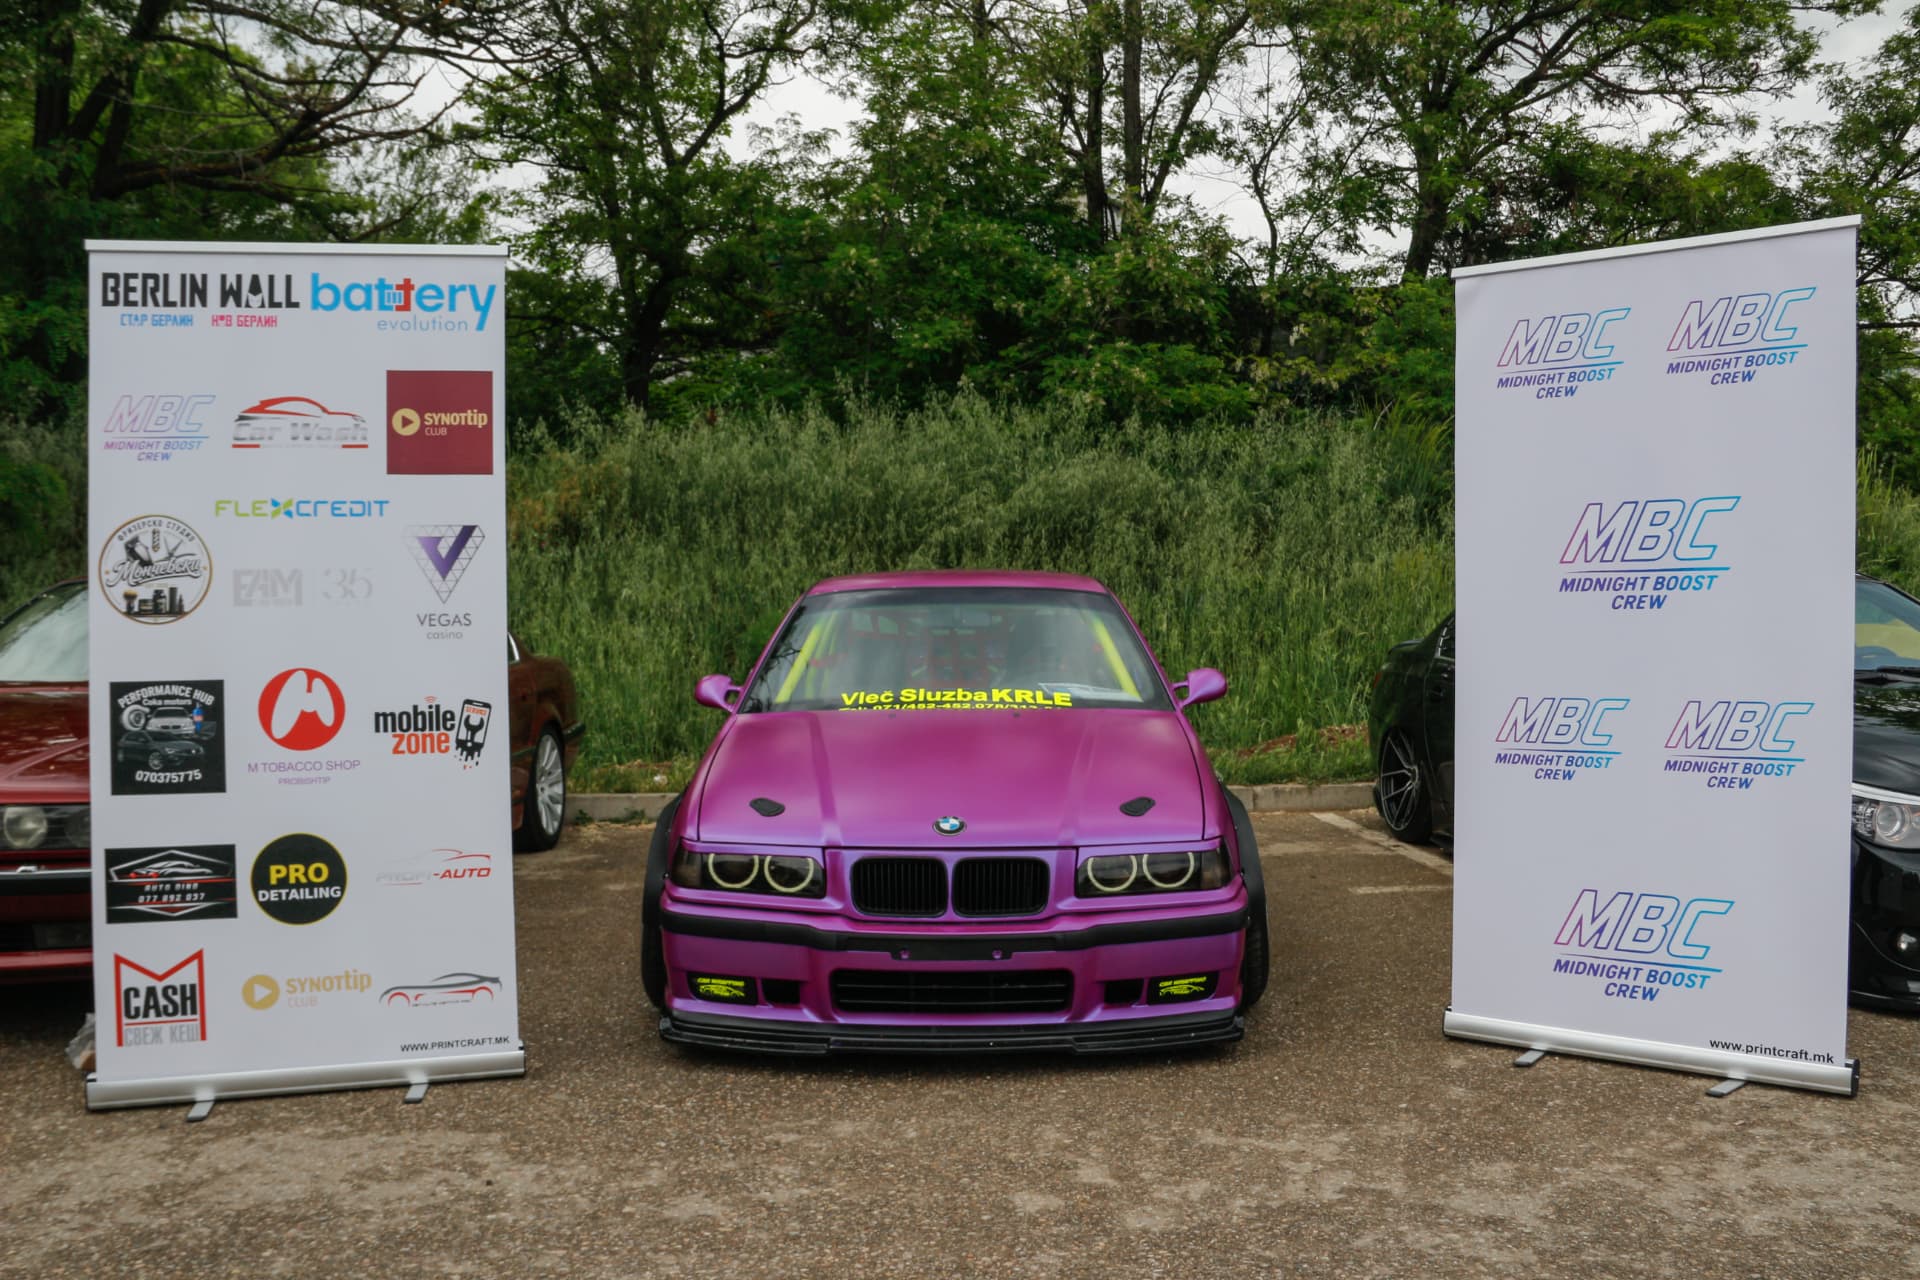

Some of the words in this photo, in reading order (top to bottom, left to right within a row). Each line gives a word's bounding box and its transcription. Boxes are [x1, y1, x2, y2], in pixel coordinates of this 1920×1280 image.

[102, 272, 208, 308] BERLIN
[220, 273, 300, 308] WALL
[310, 272, 497, 332] battery
[377, 315, 469, 332] evolution
[1666, 287, 1816, 352] MBC
[1497, 307, 1631, 367] MBC
[1666, 357, 1742, 375] MIDNIGHT
[1744, 351, 1798, 368] BOOST
[1497, 371, 1565, 389] MIDNIGHT
[1567, 367, 1616, 383] BOOST
[1710, 369, 1757, 386] CREW
[1536, 385, 1578, 400] CREW
[103, 394, 216, 433] MBC
[425, 427, 447, 436] CLUB
[103, 440, 162, 451] MIDNIGHT
[163, 440, 203, 451] BOOST
[137, 451, 172, 461] CREW
[1559, 496, 1741, 564] MBC
[1559, 576, 1651, 593] MIDNIGHT
[1652, 574, 1718, 592] BOOST
[1611, 594, 1668, 610] CREW
[416, 612, 472, 627] VEGAS
[426, 631, 463, 640] casino
[117, 684, 193, 708] PERFORMANCE
[192, 688, 215, 706] HUB
[840, 690, 894, 706] Vleč
[899, 688, 988, 702] Sluzba
[991, 688, 1073, 707] KRLE
[374, 704, 456, 733] mobile
[1495, 696, 1630, 746] MBC
[1664, 700, 1814, 752] MBC
[392, 732, 450, 755] zone
[247, 762, 259, 773] M
[260, 760, 323, 772] TOBACCO
[326, 760, 361, 771] SHOP
[1495, 753, 1563, 767] MIDNIGHT
[1565, 755, 1613, 770] BOOST
[1664, 759, 1740, 775] MIDNIGHT
[1741, 761, 1796, 777] BOOST
[135, 769, 203, 783] 070375775
[1534, 767, 1576, 781] CREW
[1706, 775, 1753, 790] CREW
[269, 862, 329, 885] PRO
[144, 883, 171, 892] AUTO
[258, 886, 342, 902] DETAILING
[1553, 888, 1735, 960] MBC
[1553, 958, 1645, 982] MIDNIGHT
[1645, 968, 1712, 990] BOOST
[287, 994, 319, 1008] CLUB
[1604, 981, 1660, 1002] CREW
[124, 983, 198, 1020] CASH
[400, 1036, 510, 1052] WWW.PRINTCRAFT.MK
[1709, 1040, 1834, 1064] www.printcraft.mk
